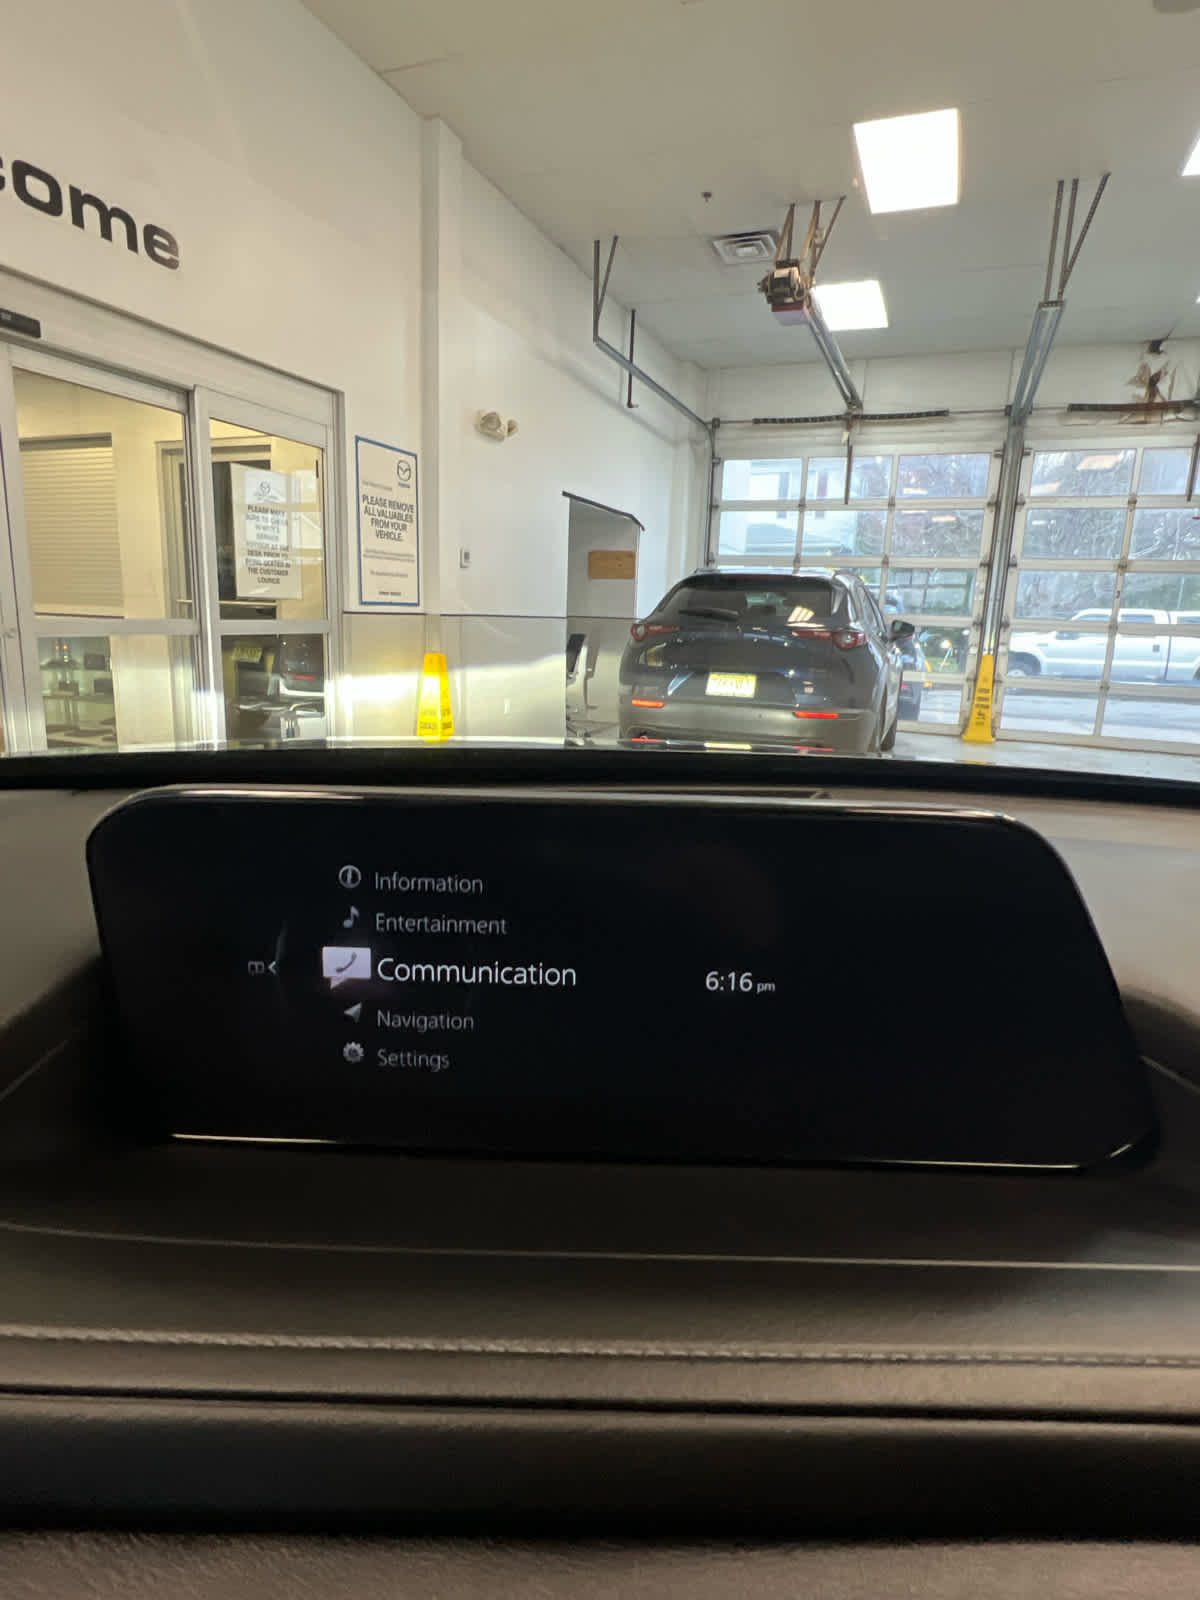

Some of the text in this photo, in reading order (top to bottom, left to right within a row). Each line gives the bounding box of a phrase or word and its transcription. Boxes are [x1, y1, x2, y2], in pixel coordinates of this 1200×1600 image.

[0, 157, 180, 270] ome
[362, 494, 414, 514] PLEASE REMOVE
[364, 506, 414, 524] ALL VALUABLES
[370, 518, 408, 532] FROM YOUR
[374, 871, 484, 894] Information
[375, 912, 508, 935] Entertainment
[376, 957, 578, 987] Communication
[705, 970, 776, 995] 6:16 pm
[376, 1009, 475, 1032] Navigation
[376, 1047, 450, 1072] Settings
